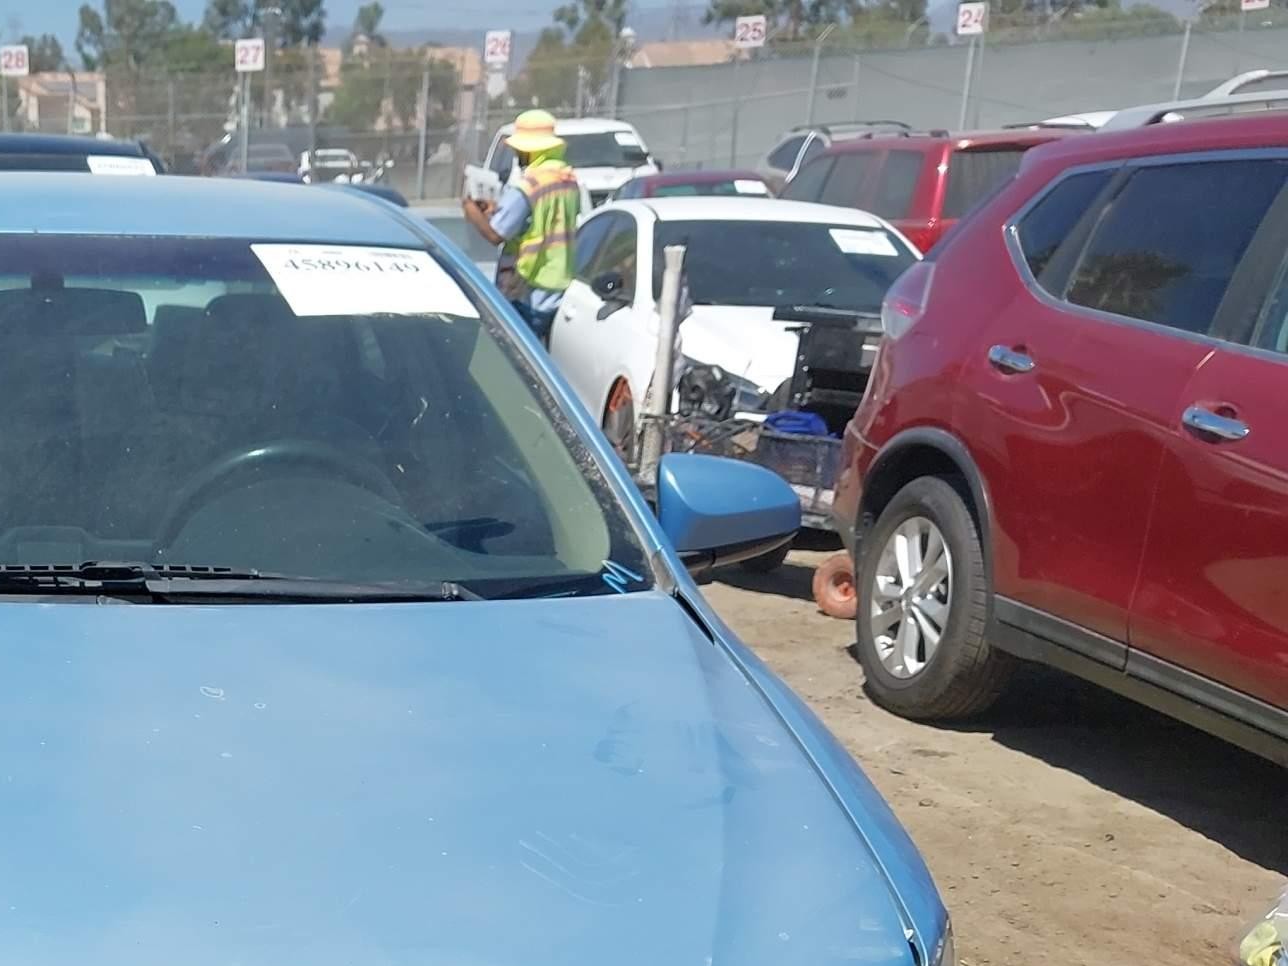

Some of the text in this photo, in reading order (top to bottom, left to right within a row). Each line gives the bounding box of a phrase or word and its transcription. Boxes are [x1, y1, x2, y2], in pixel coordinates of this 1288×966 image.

[738, 22, 764, 41] 25
[3, 50, 25, 69] 28
[239, 46, 261, 64] 27
[284, 259, 420, 272] 45896149
